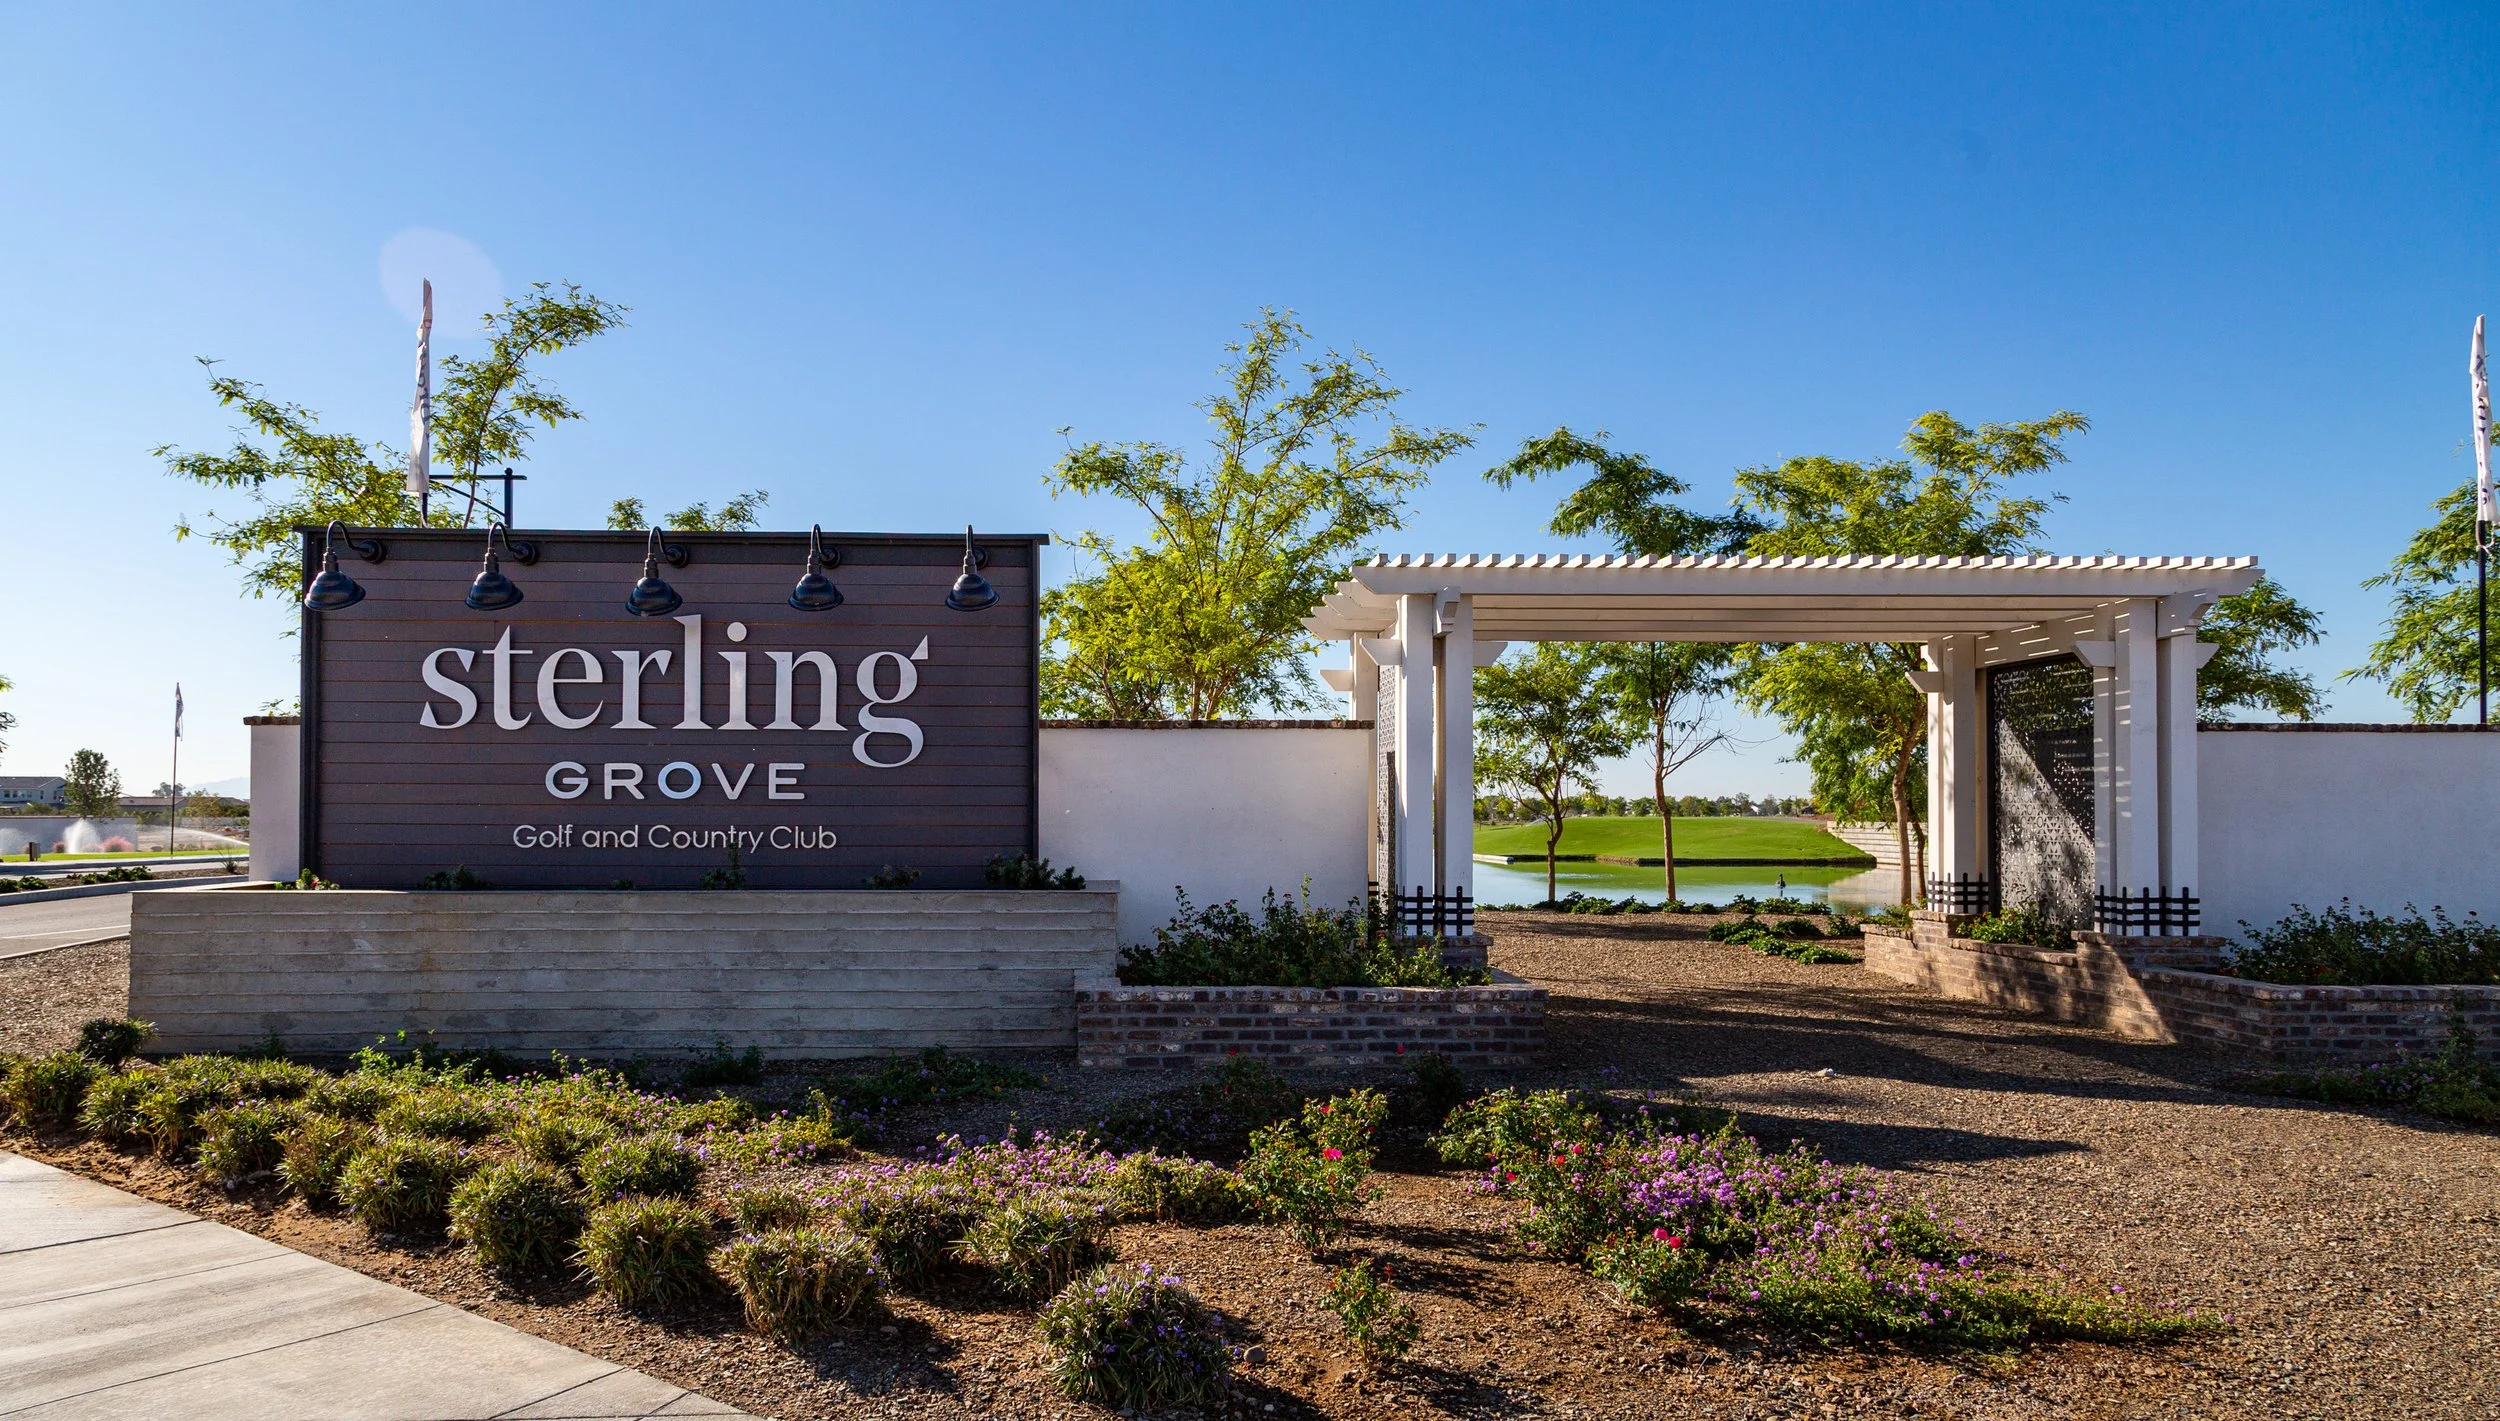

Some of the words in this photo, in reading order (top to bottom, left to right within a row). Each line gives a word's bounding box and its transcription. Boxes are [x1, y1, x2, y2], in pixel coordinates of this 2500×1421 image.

[419, 613, 929, 768] sterling
[545, 761, 805, 800] GROVE
[513, 823, 573, 848] Golf
[581, 824, 639, 848] and
[648, 824, 764, 854] Country
[770, 825, 837, 849] Club
